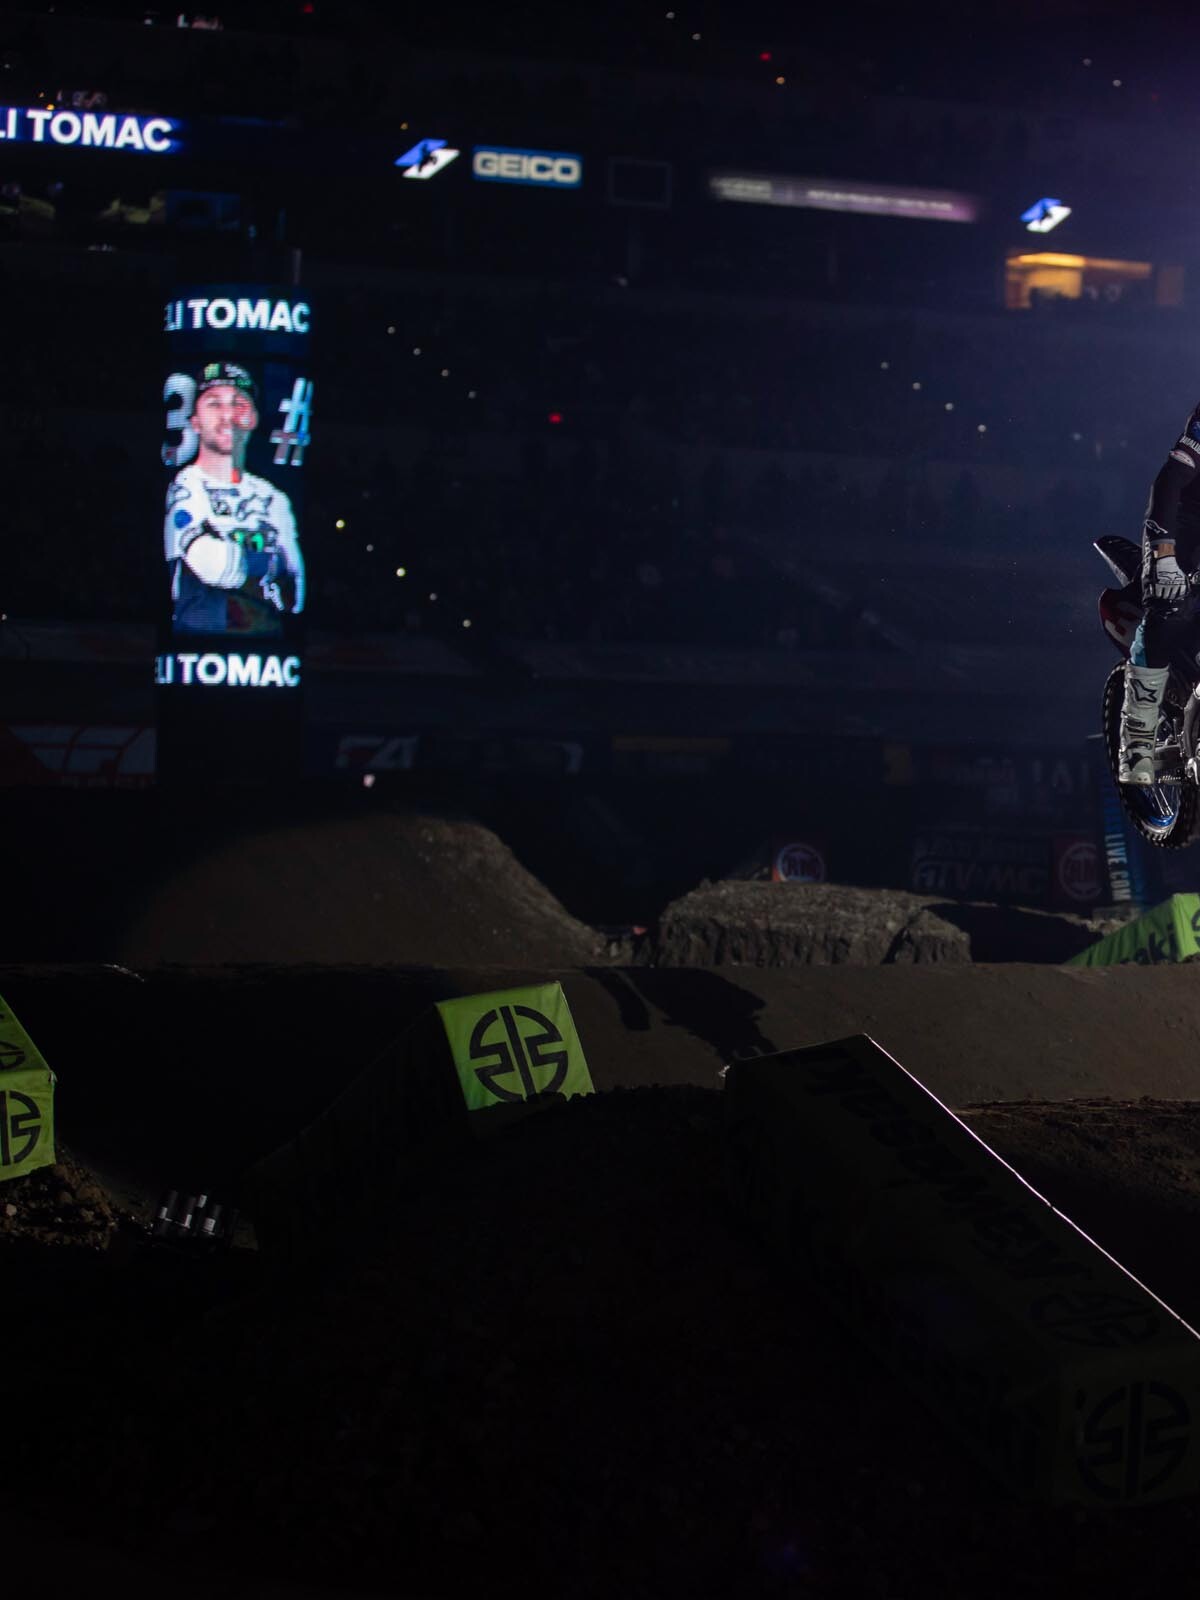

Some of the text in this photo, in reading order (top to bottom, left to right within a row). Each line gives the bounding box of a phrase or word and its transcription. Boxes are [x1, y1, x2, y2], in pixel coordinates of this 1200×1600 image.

[27, 109, 172, 152] TOMAC
[473, 150, 582, 184] GEICO
[187, 298, 310, 332] TOMAC
[177, 653, 300, 687] TOMAC
